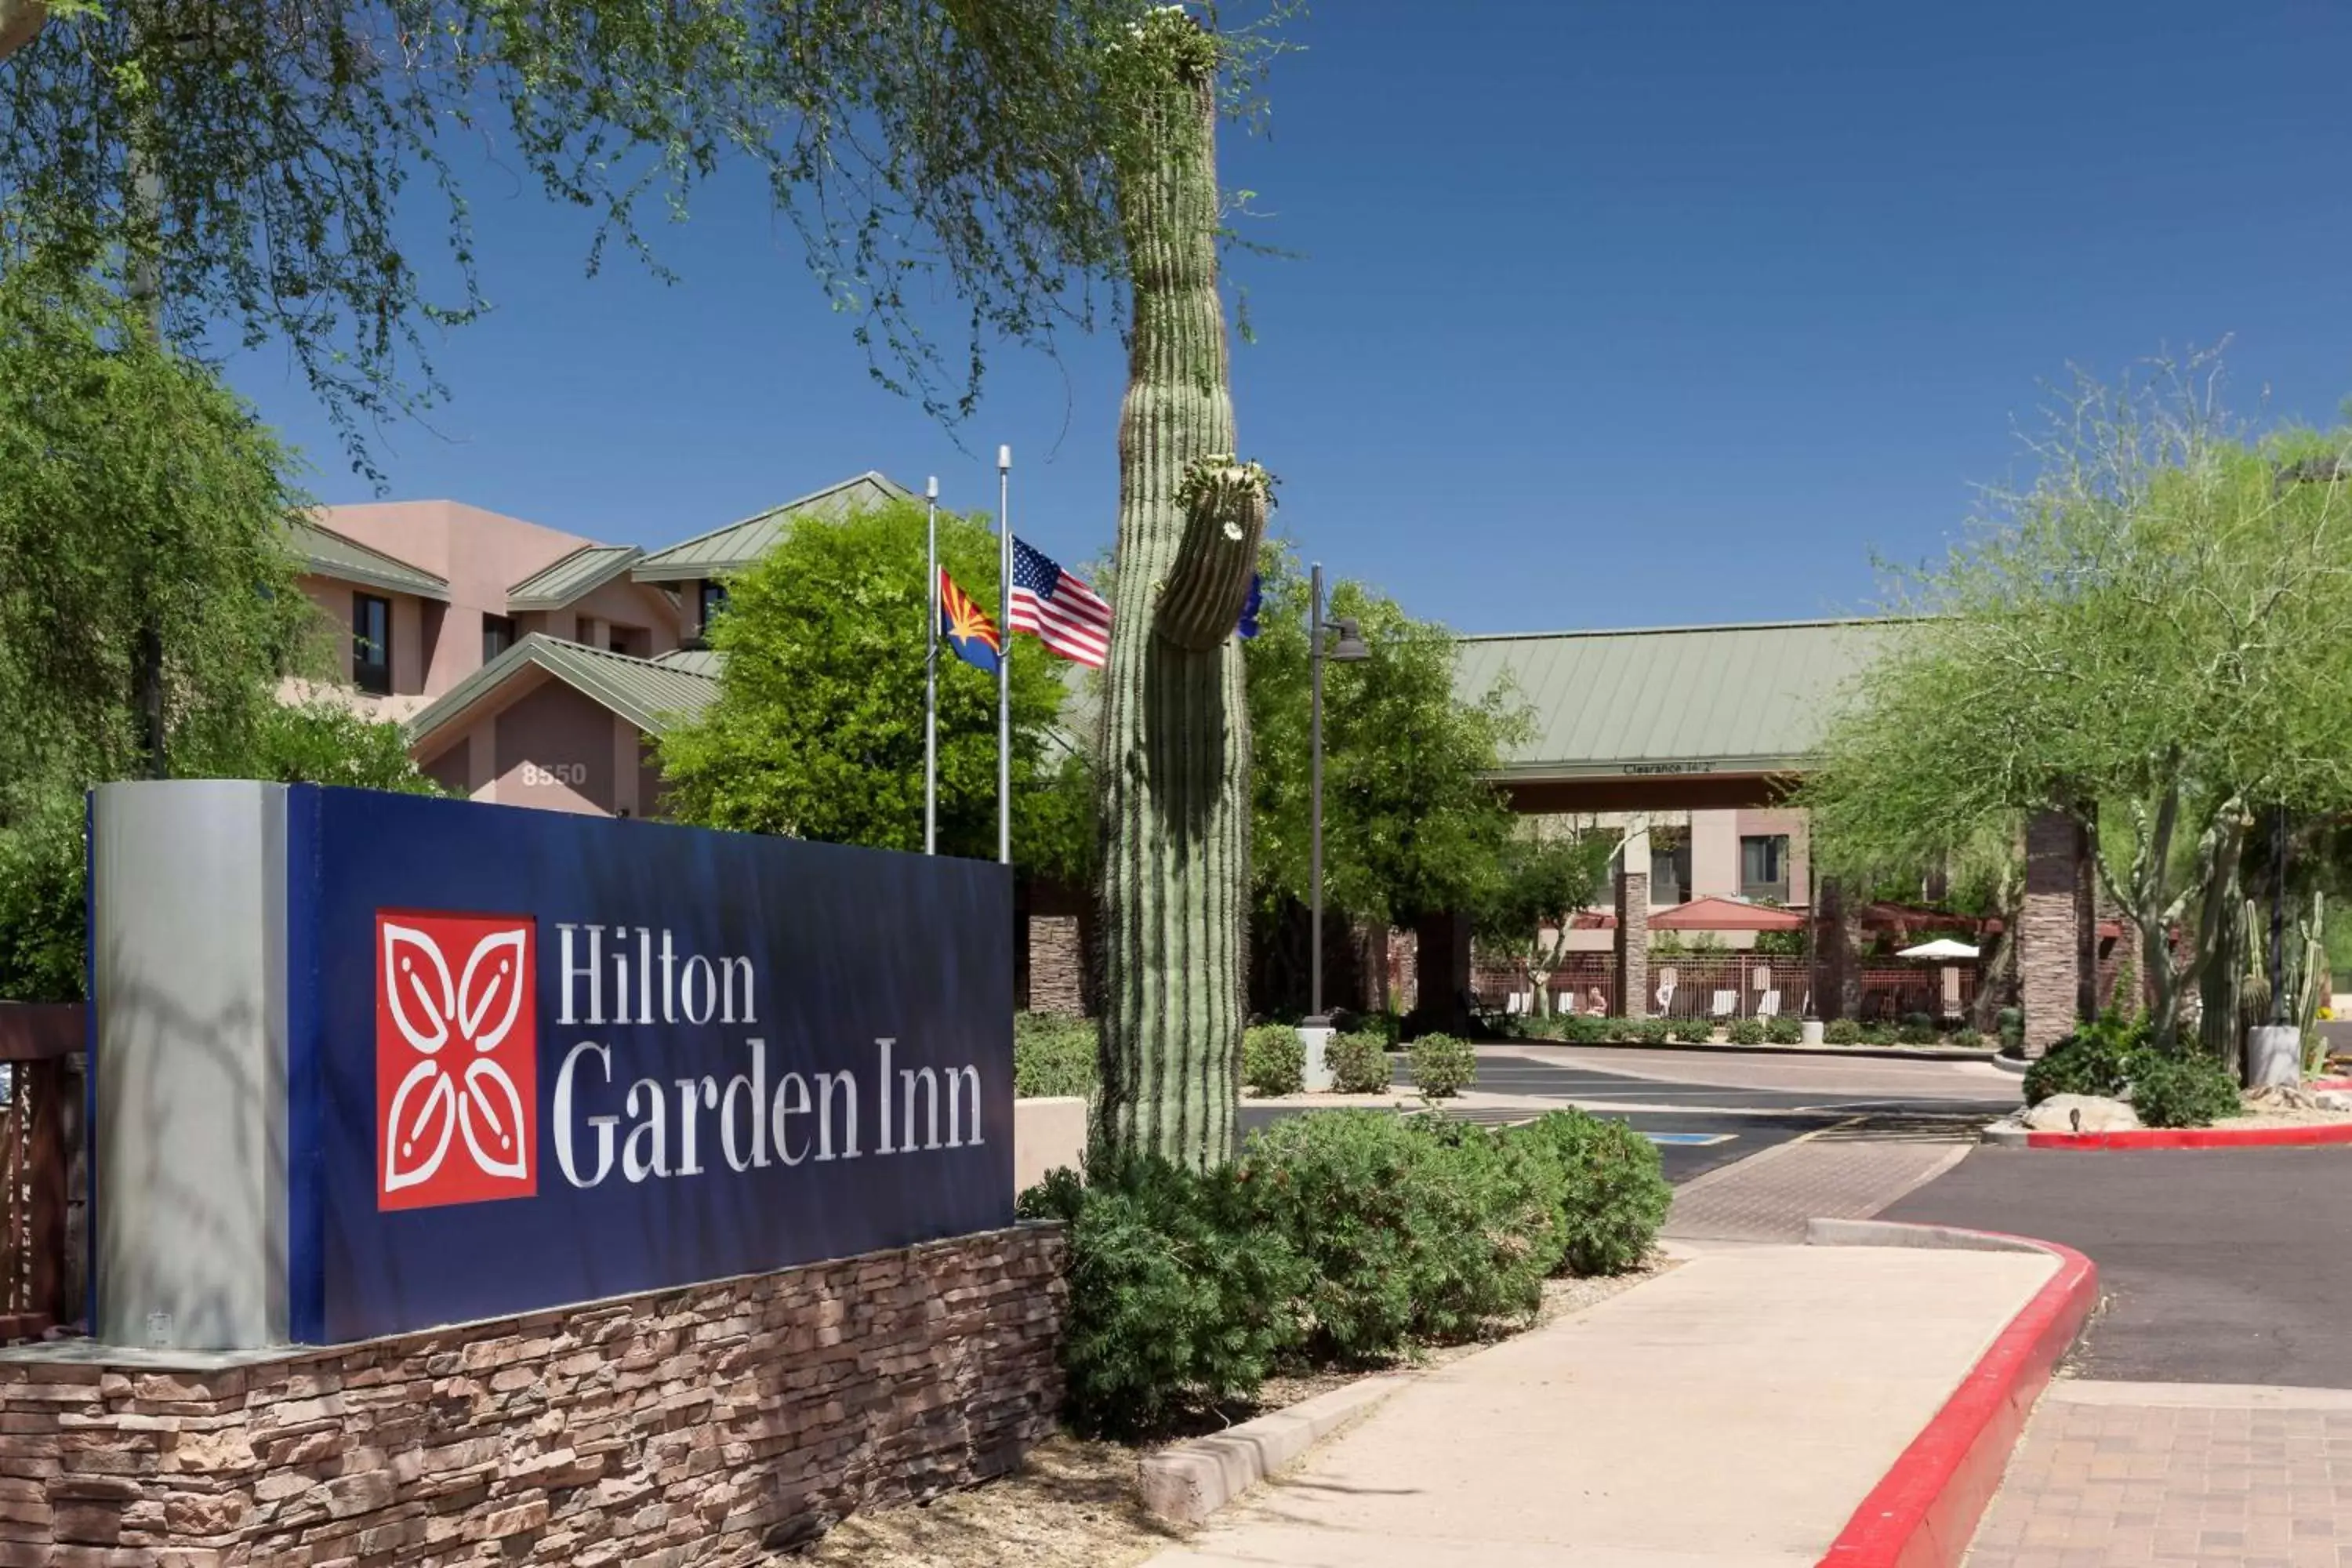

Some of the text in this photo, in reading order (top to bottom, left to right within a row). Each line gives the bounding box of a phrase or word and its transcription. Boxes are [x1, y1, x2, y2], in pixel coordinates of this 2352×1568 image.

[522, 764, 586, 786] 8550
[1624, 764, 1682, 775] Clearance
[556, 924, 757, 1025] Hilton
[553, 1038, 985, 1189] Garden Inn
